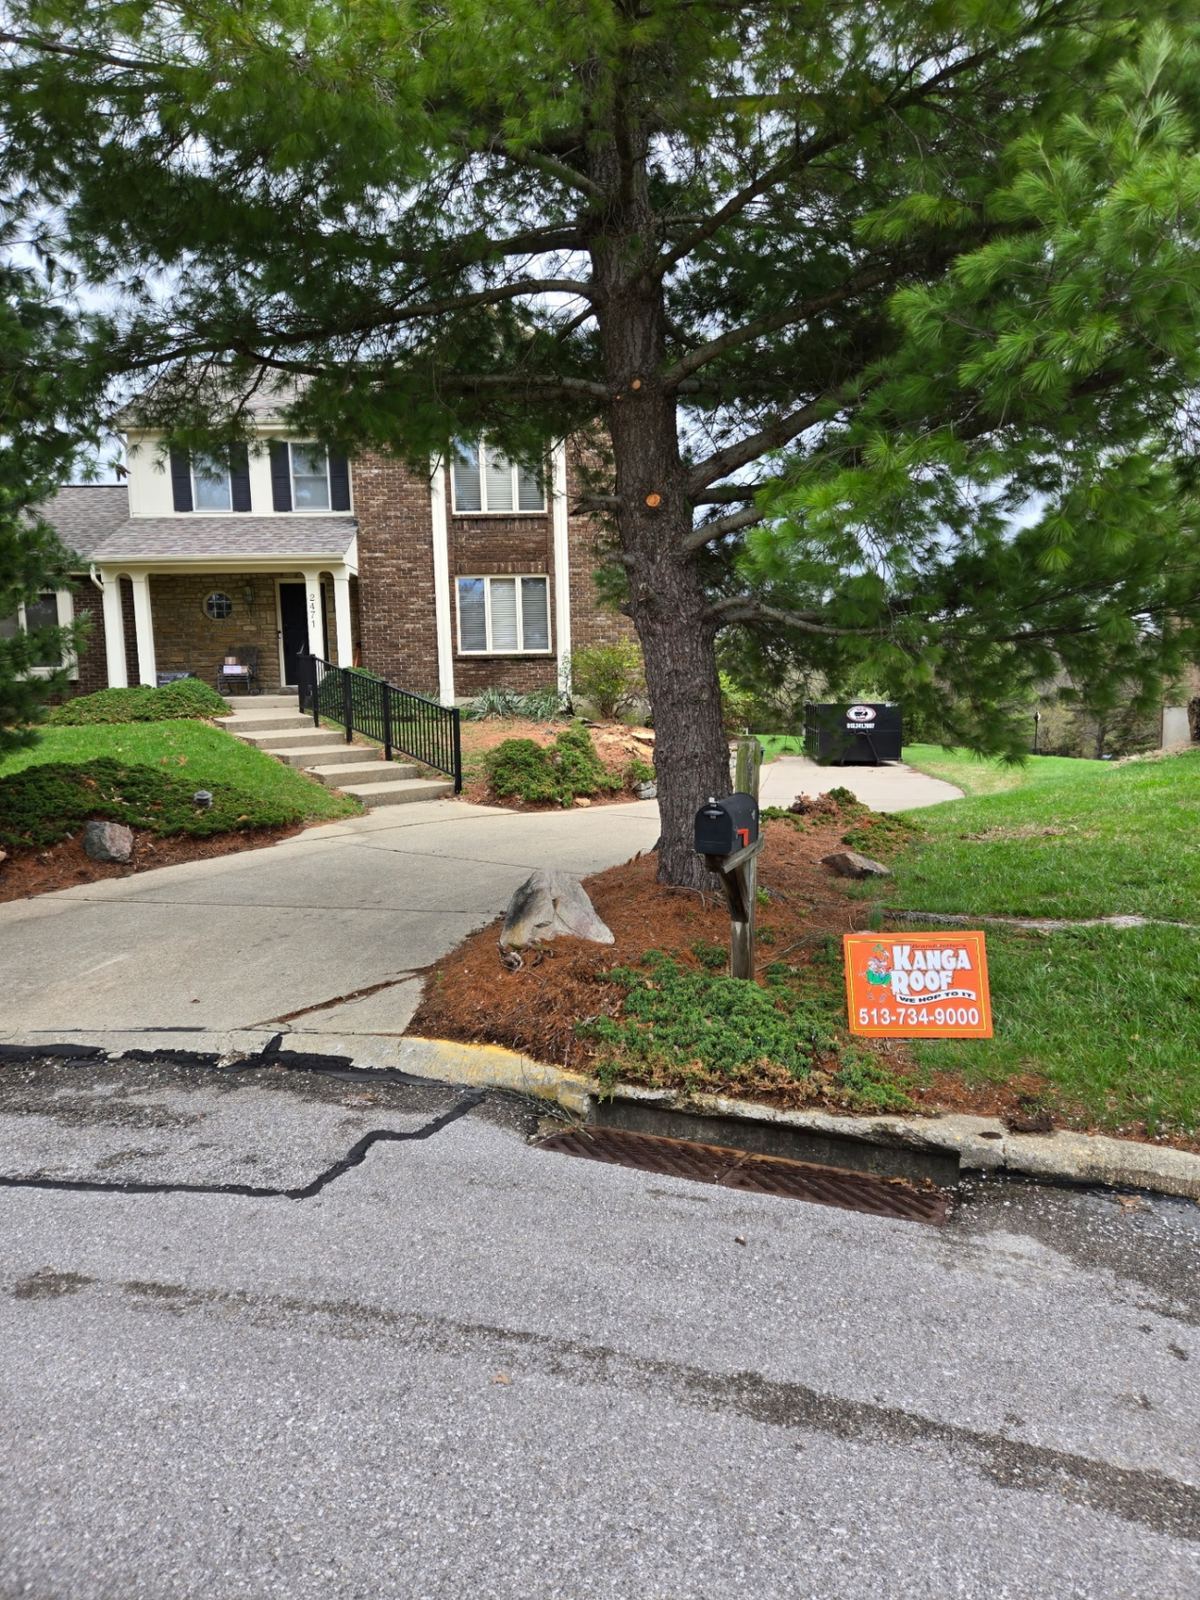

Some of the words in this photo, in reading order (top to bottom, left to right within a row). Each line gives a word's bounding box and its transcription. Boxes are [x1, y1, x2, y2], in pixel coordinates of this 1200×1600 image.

[892, 945, 972, 971] KANGA
[890, 970, 954, 995] ROOF
[918, 994, 941, 1003] HOP
[859, 1007, 979, 1026] 513-734-9000
